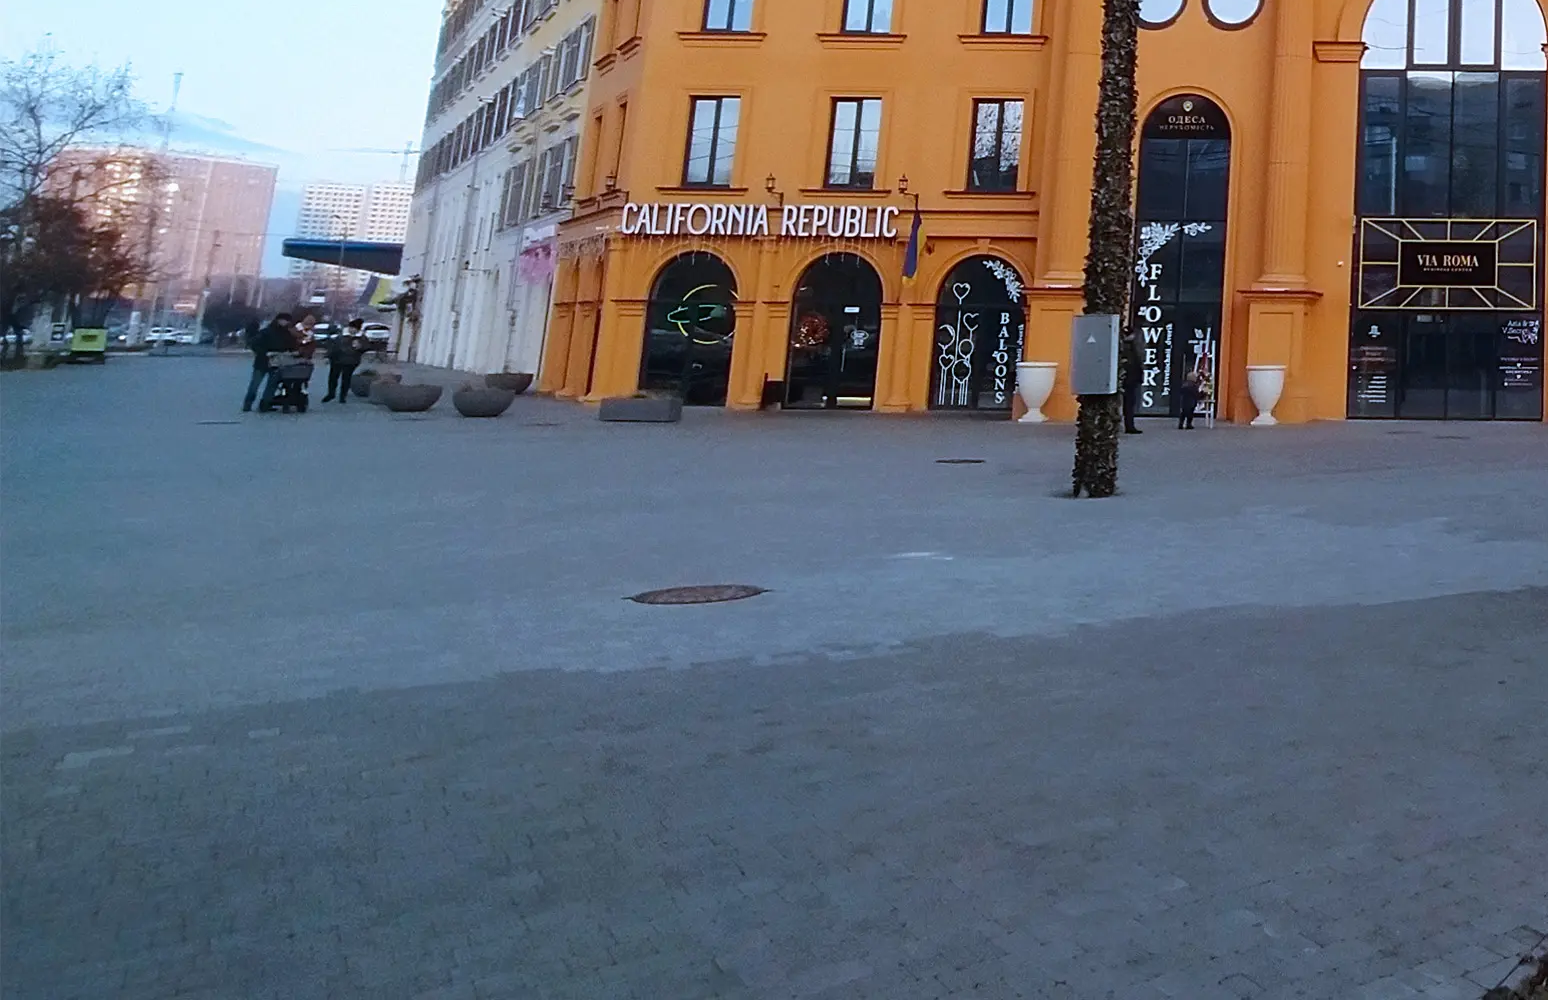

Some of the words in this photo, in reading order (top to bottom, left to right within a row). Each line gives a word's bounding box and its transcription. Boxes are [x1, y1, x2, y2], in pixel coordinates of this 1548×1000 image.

[1168, 115, 1206, 124] ОДЕСА
[620, 202, 769, 236] CALIFORNIA
[781, 204, 899, 238] REPUBLIC
[1417, 254, 1438, 267] VIA
[1443, 254, 1479, 267] ROMA
[1141, 263, 1163, 408] FLOWERS
[993, 312, 1011, 404] BALOONS
